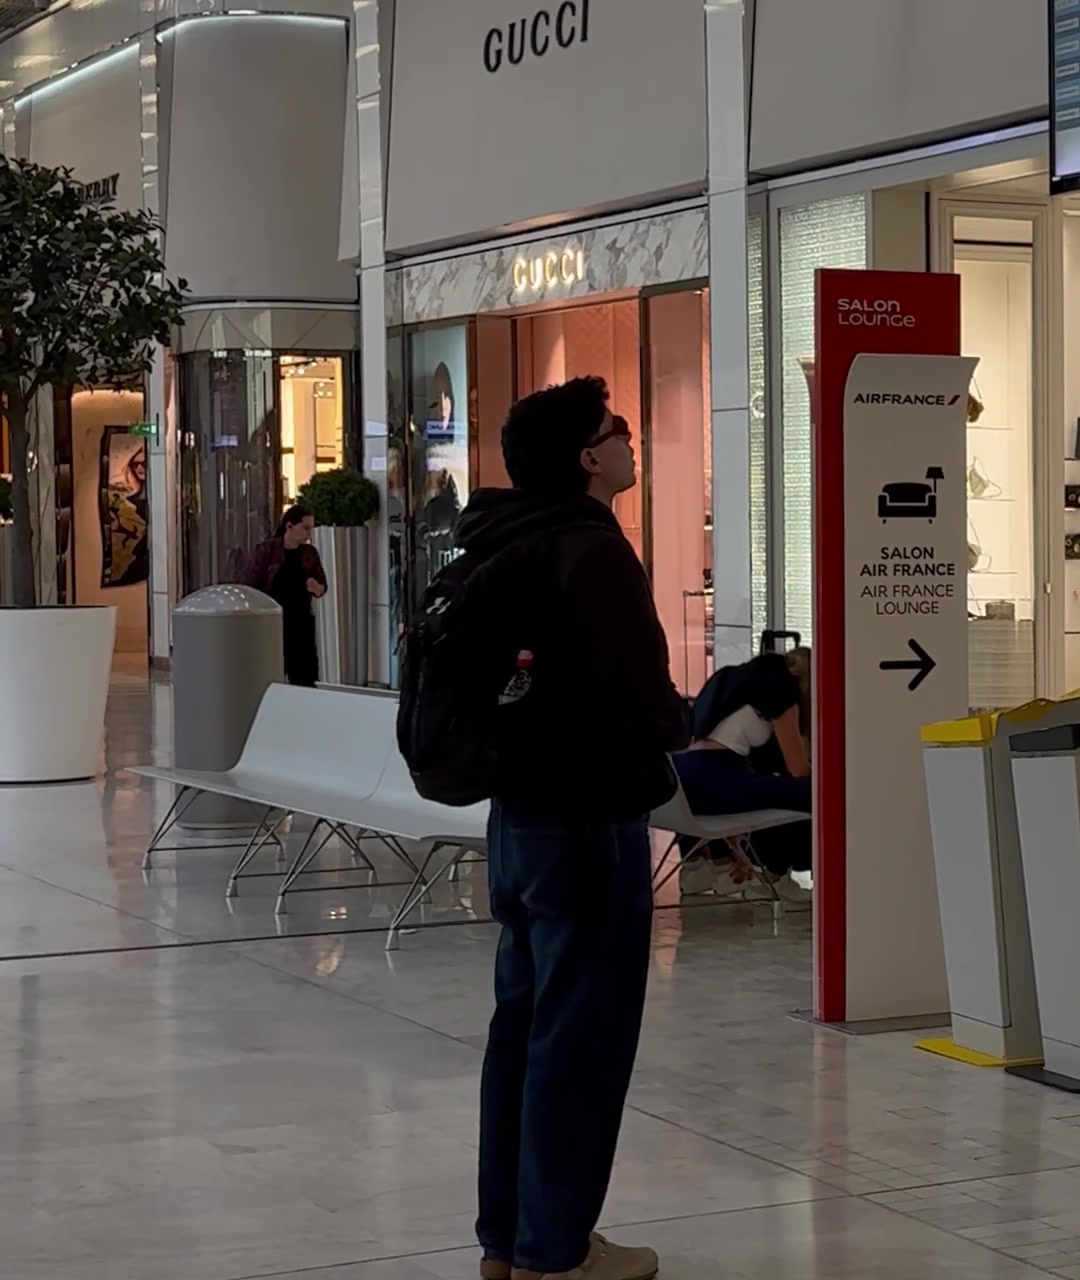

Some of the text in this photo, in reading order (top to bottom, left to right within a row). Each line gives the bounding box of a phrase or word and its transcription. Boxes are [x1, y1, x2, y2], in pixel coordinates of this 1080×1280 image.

[512, 249, 586, 291] GUCCI
[880, 546, 934, 560] SALON
[859, 563, 955, 577] AIR FRANCE
[860, 583, 954, 598] AIR FRANCE
[876, 600, 940, 615] LOUNGE
